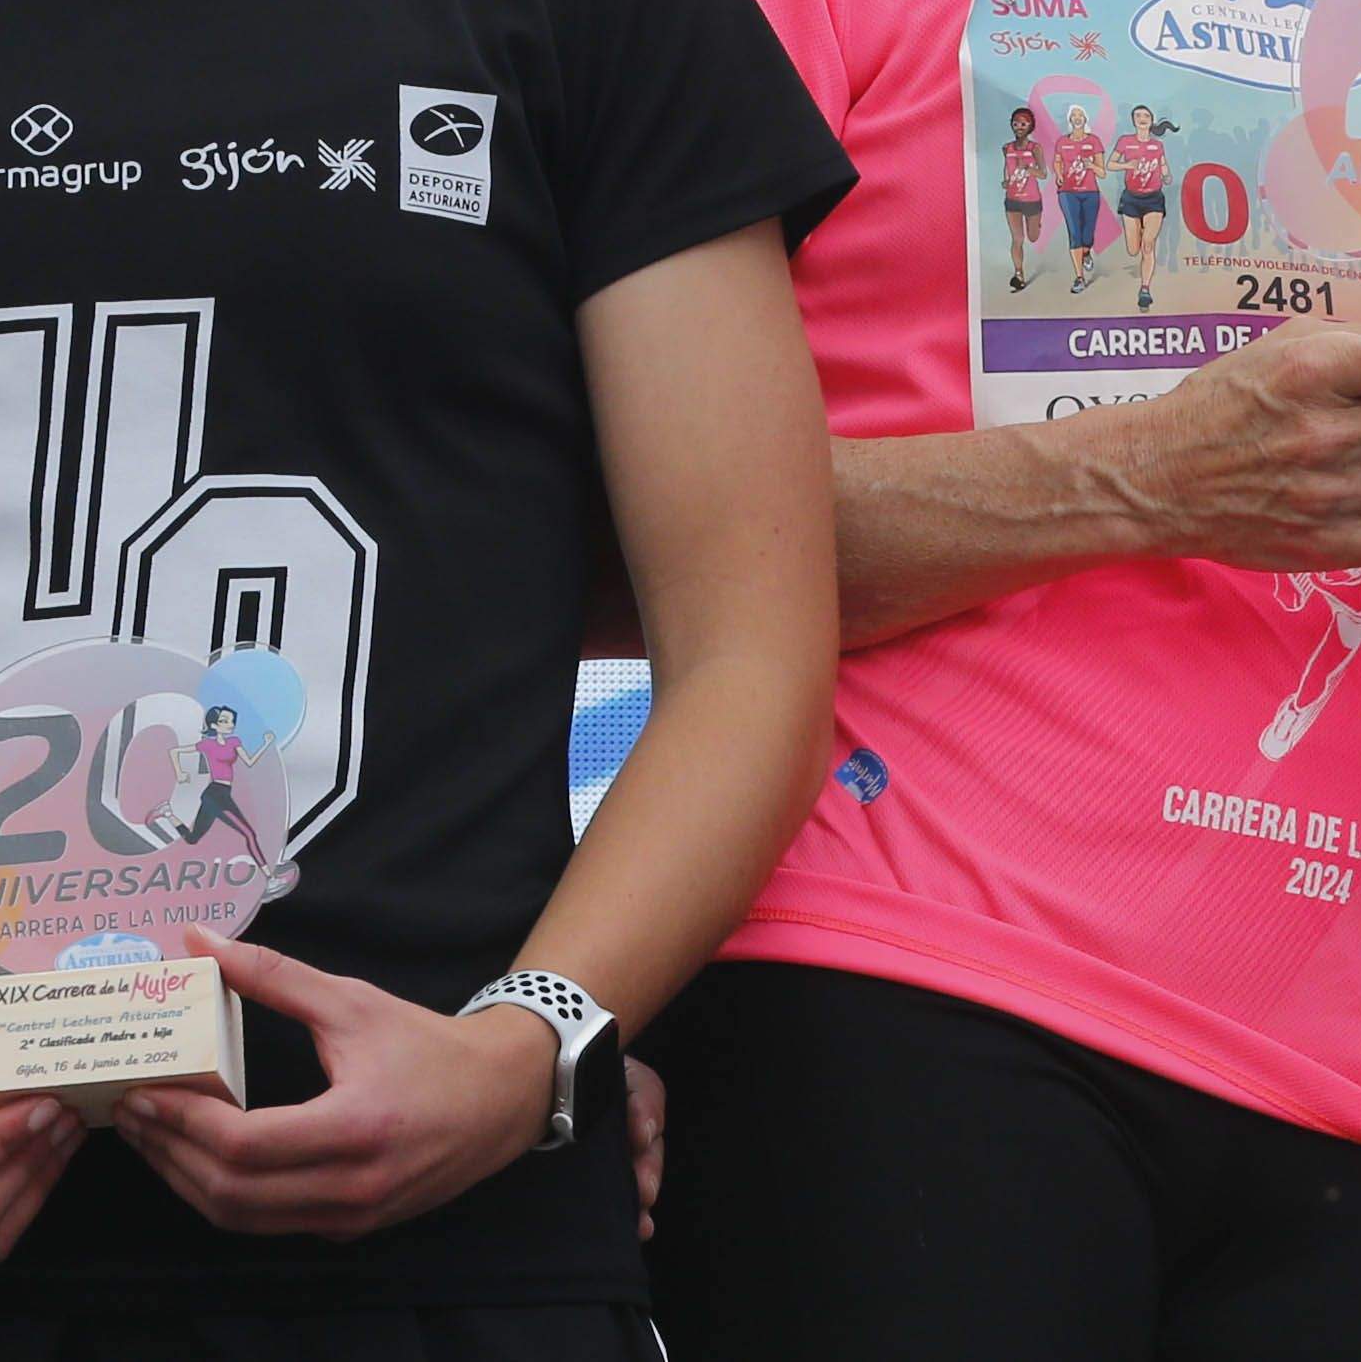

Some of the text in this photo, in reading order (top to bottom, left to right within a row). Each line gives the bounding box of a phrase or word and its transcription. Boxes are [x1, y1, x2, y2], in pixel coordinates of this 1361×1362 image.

[1191, 4, 1269, 26] CENTRAL
[989, 31, 1062, 57] gijón
[1154, 9, 1301, 63] ASTURI
[179, 138, 305, 191] gijón
[408, 172, 483, 197] DEPORTE
[408, 191, 481, 213] ASTURIANO
[1254, 259, 1320, 274] VIOLENCIA
[1236, 274, 1335, 316] 2481
[1068, 325, 1252, 357] CARRERA DE
[1162, 785, 1298, 845] CARRERA
[1305, 811, 1342, 853] DE
[1284, 857, 1354, 905] 2024
[94, 912, 120, 931] DE
[128, 908, 154, 927] LA
[164, 902, 238, 925] MUJER
[33, 982, 97, 1002] Carrera
[100, 979, 115, 995] de
[118, 977, 130, 993] la
[129, 968, 196, 1004] Mujer
[62, 1014, 112, 1029] Lechera
[100, 1030, 137, 1044] Madre
[74, 1058, 87, 1070] de
[91, 1056, 121, 1071] junio
[125, 1054, 139, 1066] de
[143, 1050, 179, 1065] 2024
